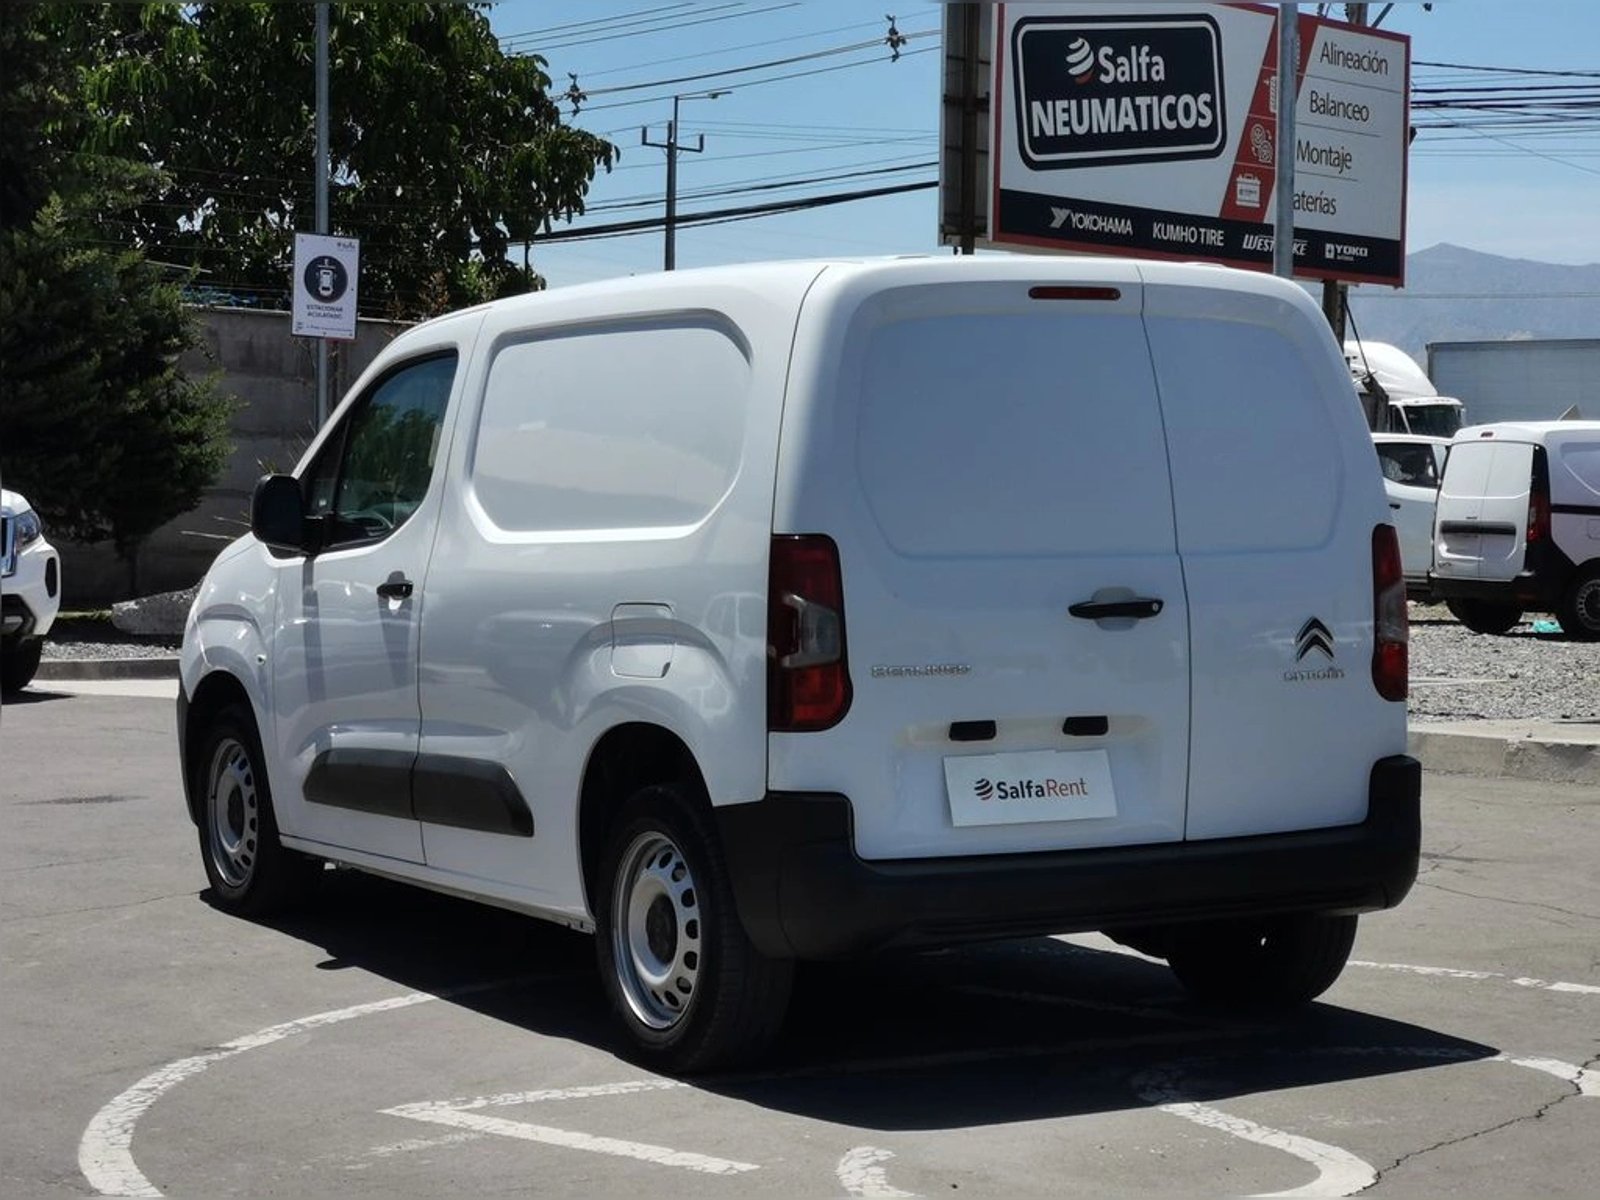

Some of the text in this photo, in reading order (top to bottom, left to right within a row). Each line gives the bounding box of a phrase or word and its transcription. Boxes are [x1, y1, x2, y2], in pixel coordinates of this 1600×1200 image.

[1098, 45, 1165, 83] Salfa
[1320, 41, 1388, 75] Alineación
[1031, 93, 1213, 137] NEUMATICOS
[1310, 90, 1370, 122] Balanceo
[1296, 139, 1353, 174] Montaje
[1292, 190, 1337, 215] aterías
[1070, 212, 1133, 236] YOKOHAMA
[1152, 222, 1225, 246] KUMHO TIRE
[996, 777, 1089, 800] SalfaRent
